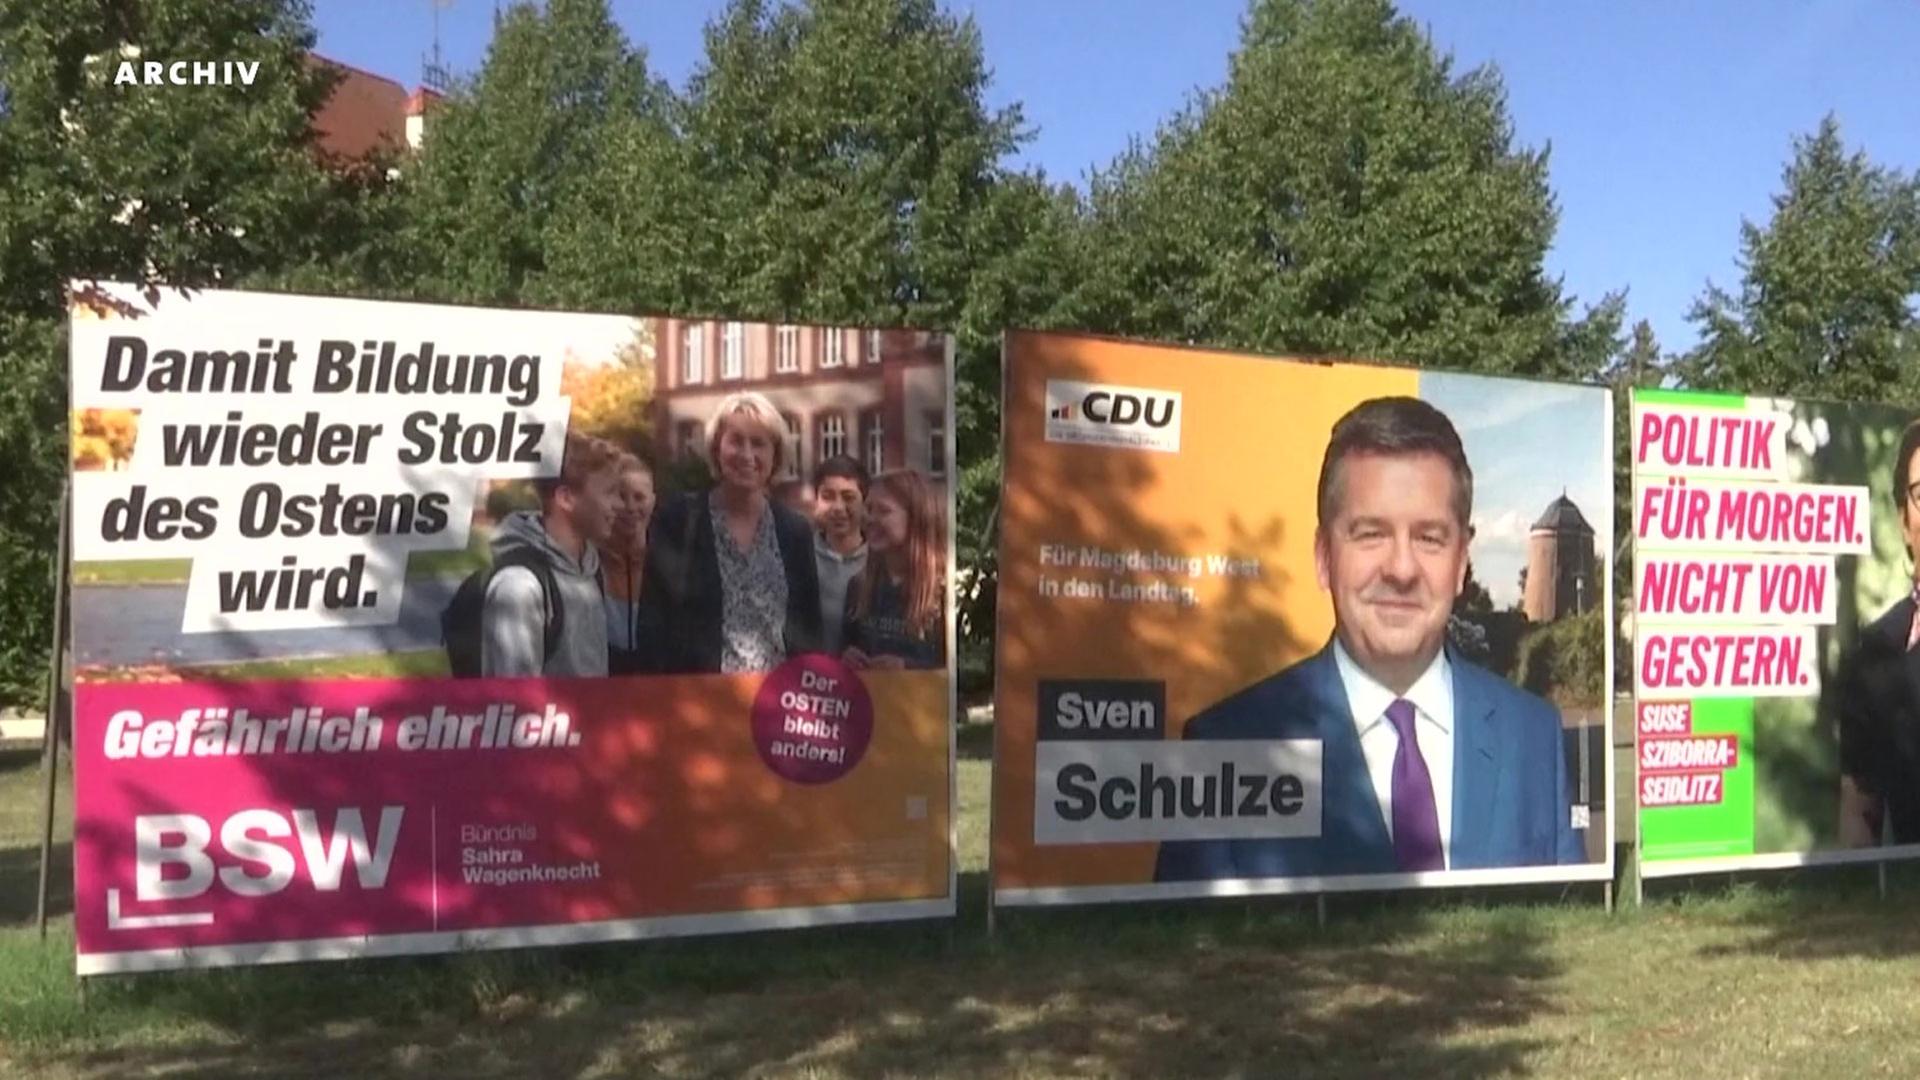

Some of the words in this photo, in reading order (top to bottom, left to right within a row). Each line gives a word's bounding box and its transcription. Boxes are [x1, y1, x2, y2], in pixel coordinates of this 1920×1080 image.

[101, 336, 297, 393] Damit
[313, 340, 541, 405] Bildung
[1082, 391, 1175, 429] CDU
[163, 412, 382, 466] wieder
[398, 411, 544, 463] Stolz
[1638, 413, 1775, 470] POLITIK
[102, 485, 218, 542] des
[239, 482, 449, 538] Ostens
[1638, 476, 1711, 541] FÜR
[1715, 490, 1863, 544] MORGEN.
[1039, 545, 1076, 566] Für
[1079, 547, 1202, 577] Magdeburg
[1207, 554, 1260, 577] West
[218, 555, 377, 613] wird.
[1039, 575, 1059, 596] in
[1063, 577, 1103, 599] den
[1109, 579, 1200, 605] Landtag.
[1639, 562, 1753, 614] NICHT
[1760, 564, 1826, 614] VON
[1641, 635, 1808, 687] GESTERN.
[802, 670, 837, 692] Der
[780, 691, 850, 719] OSTEN
[1056, 693, 1155, 730] Sven
[1640, 704, 1689, 733] SUSE
[104, 706, 384, 760] Gefährlich
[396, 704, 581, 750] ehrlich.
[784, 715, 840, 740] bleibt
[771, 740, 845, 764] anders!
[1640, 739, 1735, 769] SZIBORRA-
[1054, 762, 1304, 822] Schulze
[1640, 774, 1721, 805] SEIDLITZ
[461, 823, 537, 843] Bündnis
[135, 805, 405, 902] BSW
[462, 847, 523, 865] Sahra
[462, 861, 601, 886] Wagenknecht
